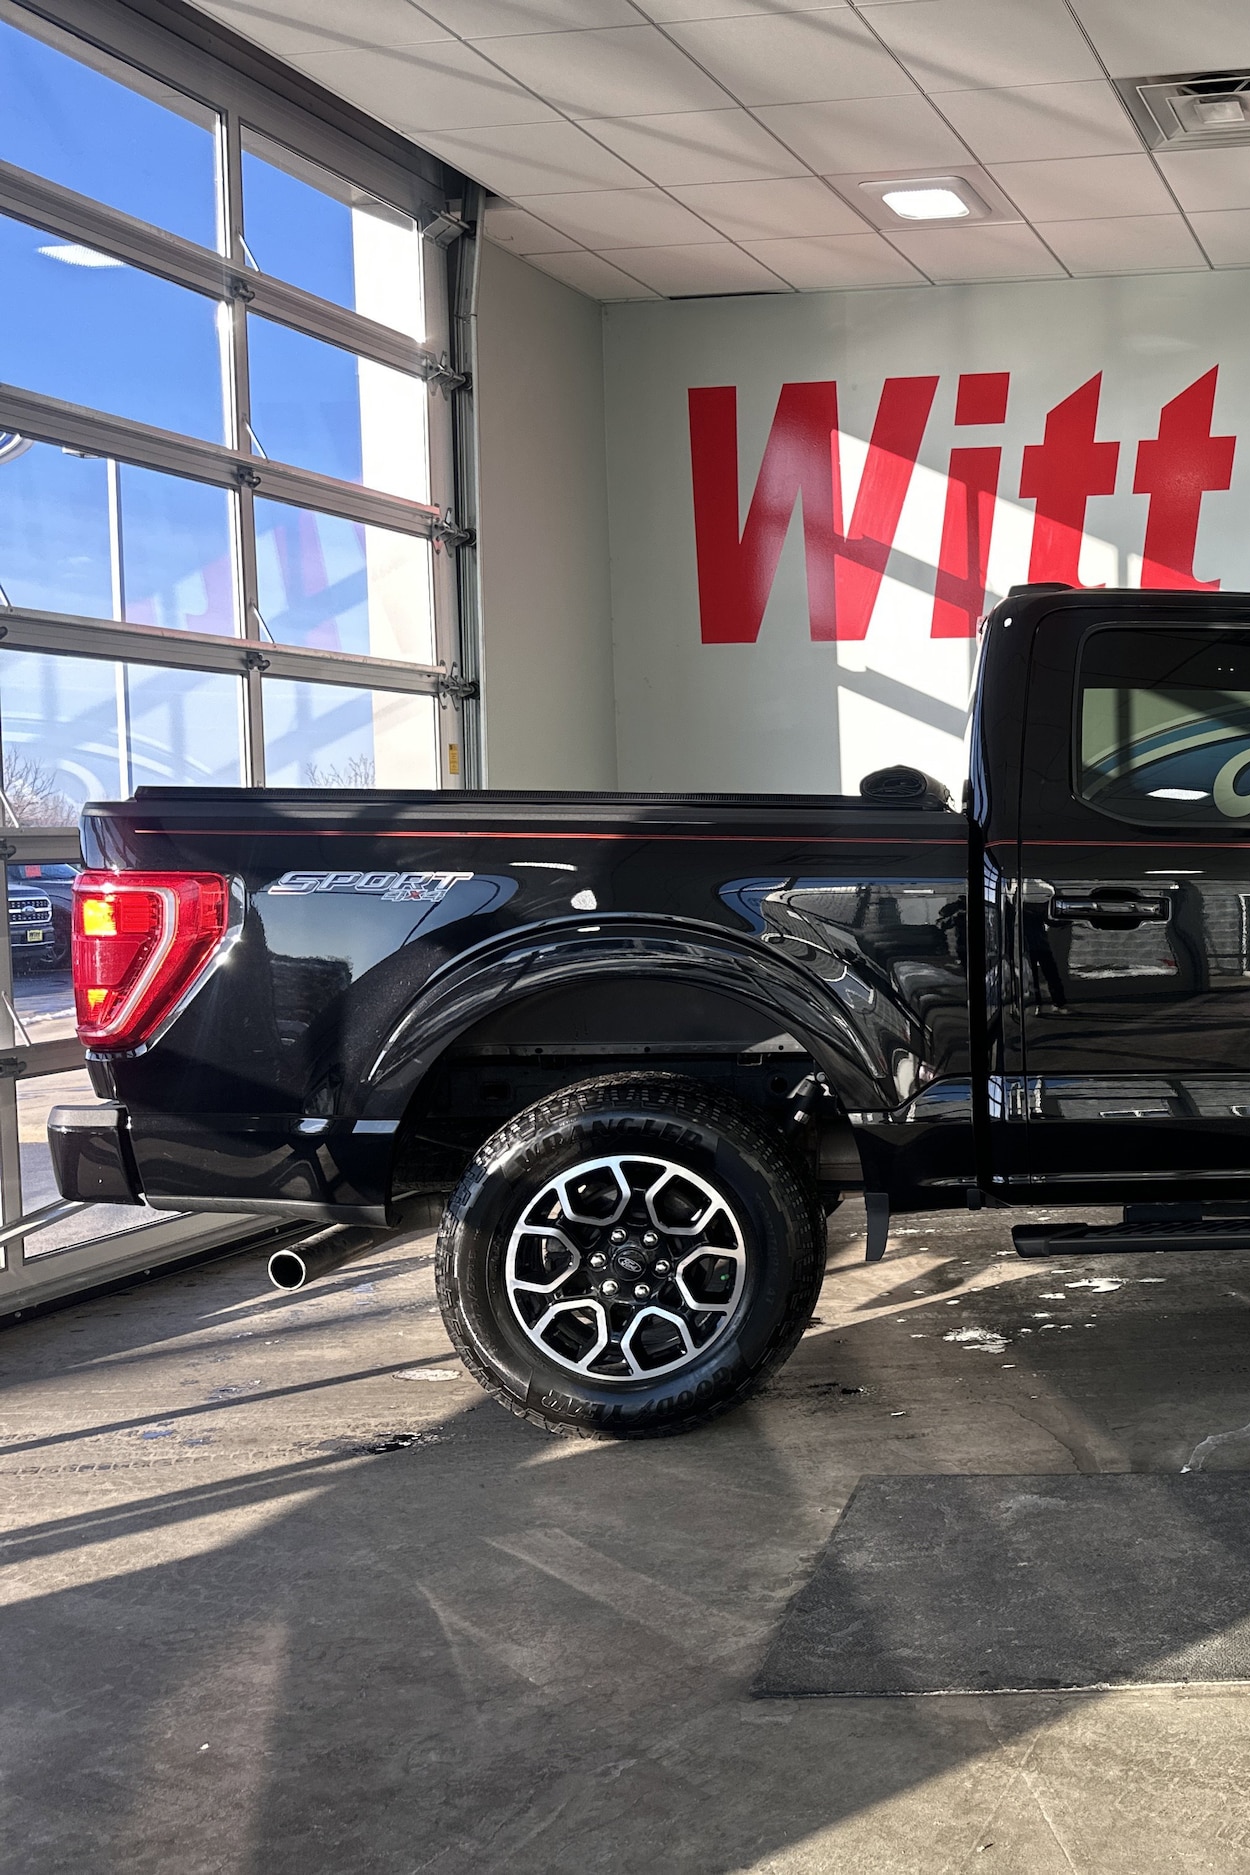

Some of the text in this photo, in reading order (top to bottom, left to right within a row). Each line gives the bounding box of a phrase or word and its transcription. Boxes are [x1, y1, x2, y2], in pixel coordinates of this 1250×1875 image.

[268, 871, 474, 895] SPORT
[513, 1117, 704, 1173] WRANGLER
[541, 1366, 733, 1422] GOODYEAR
